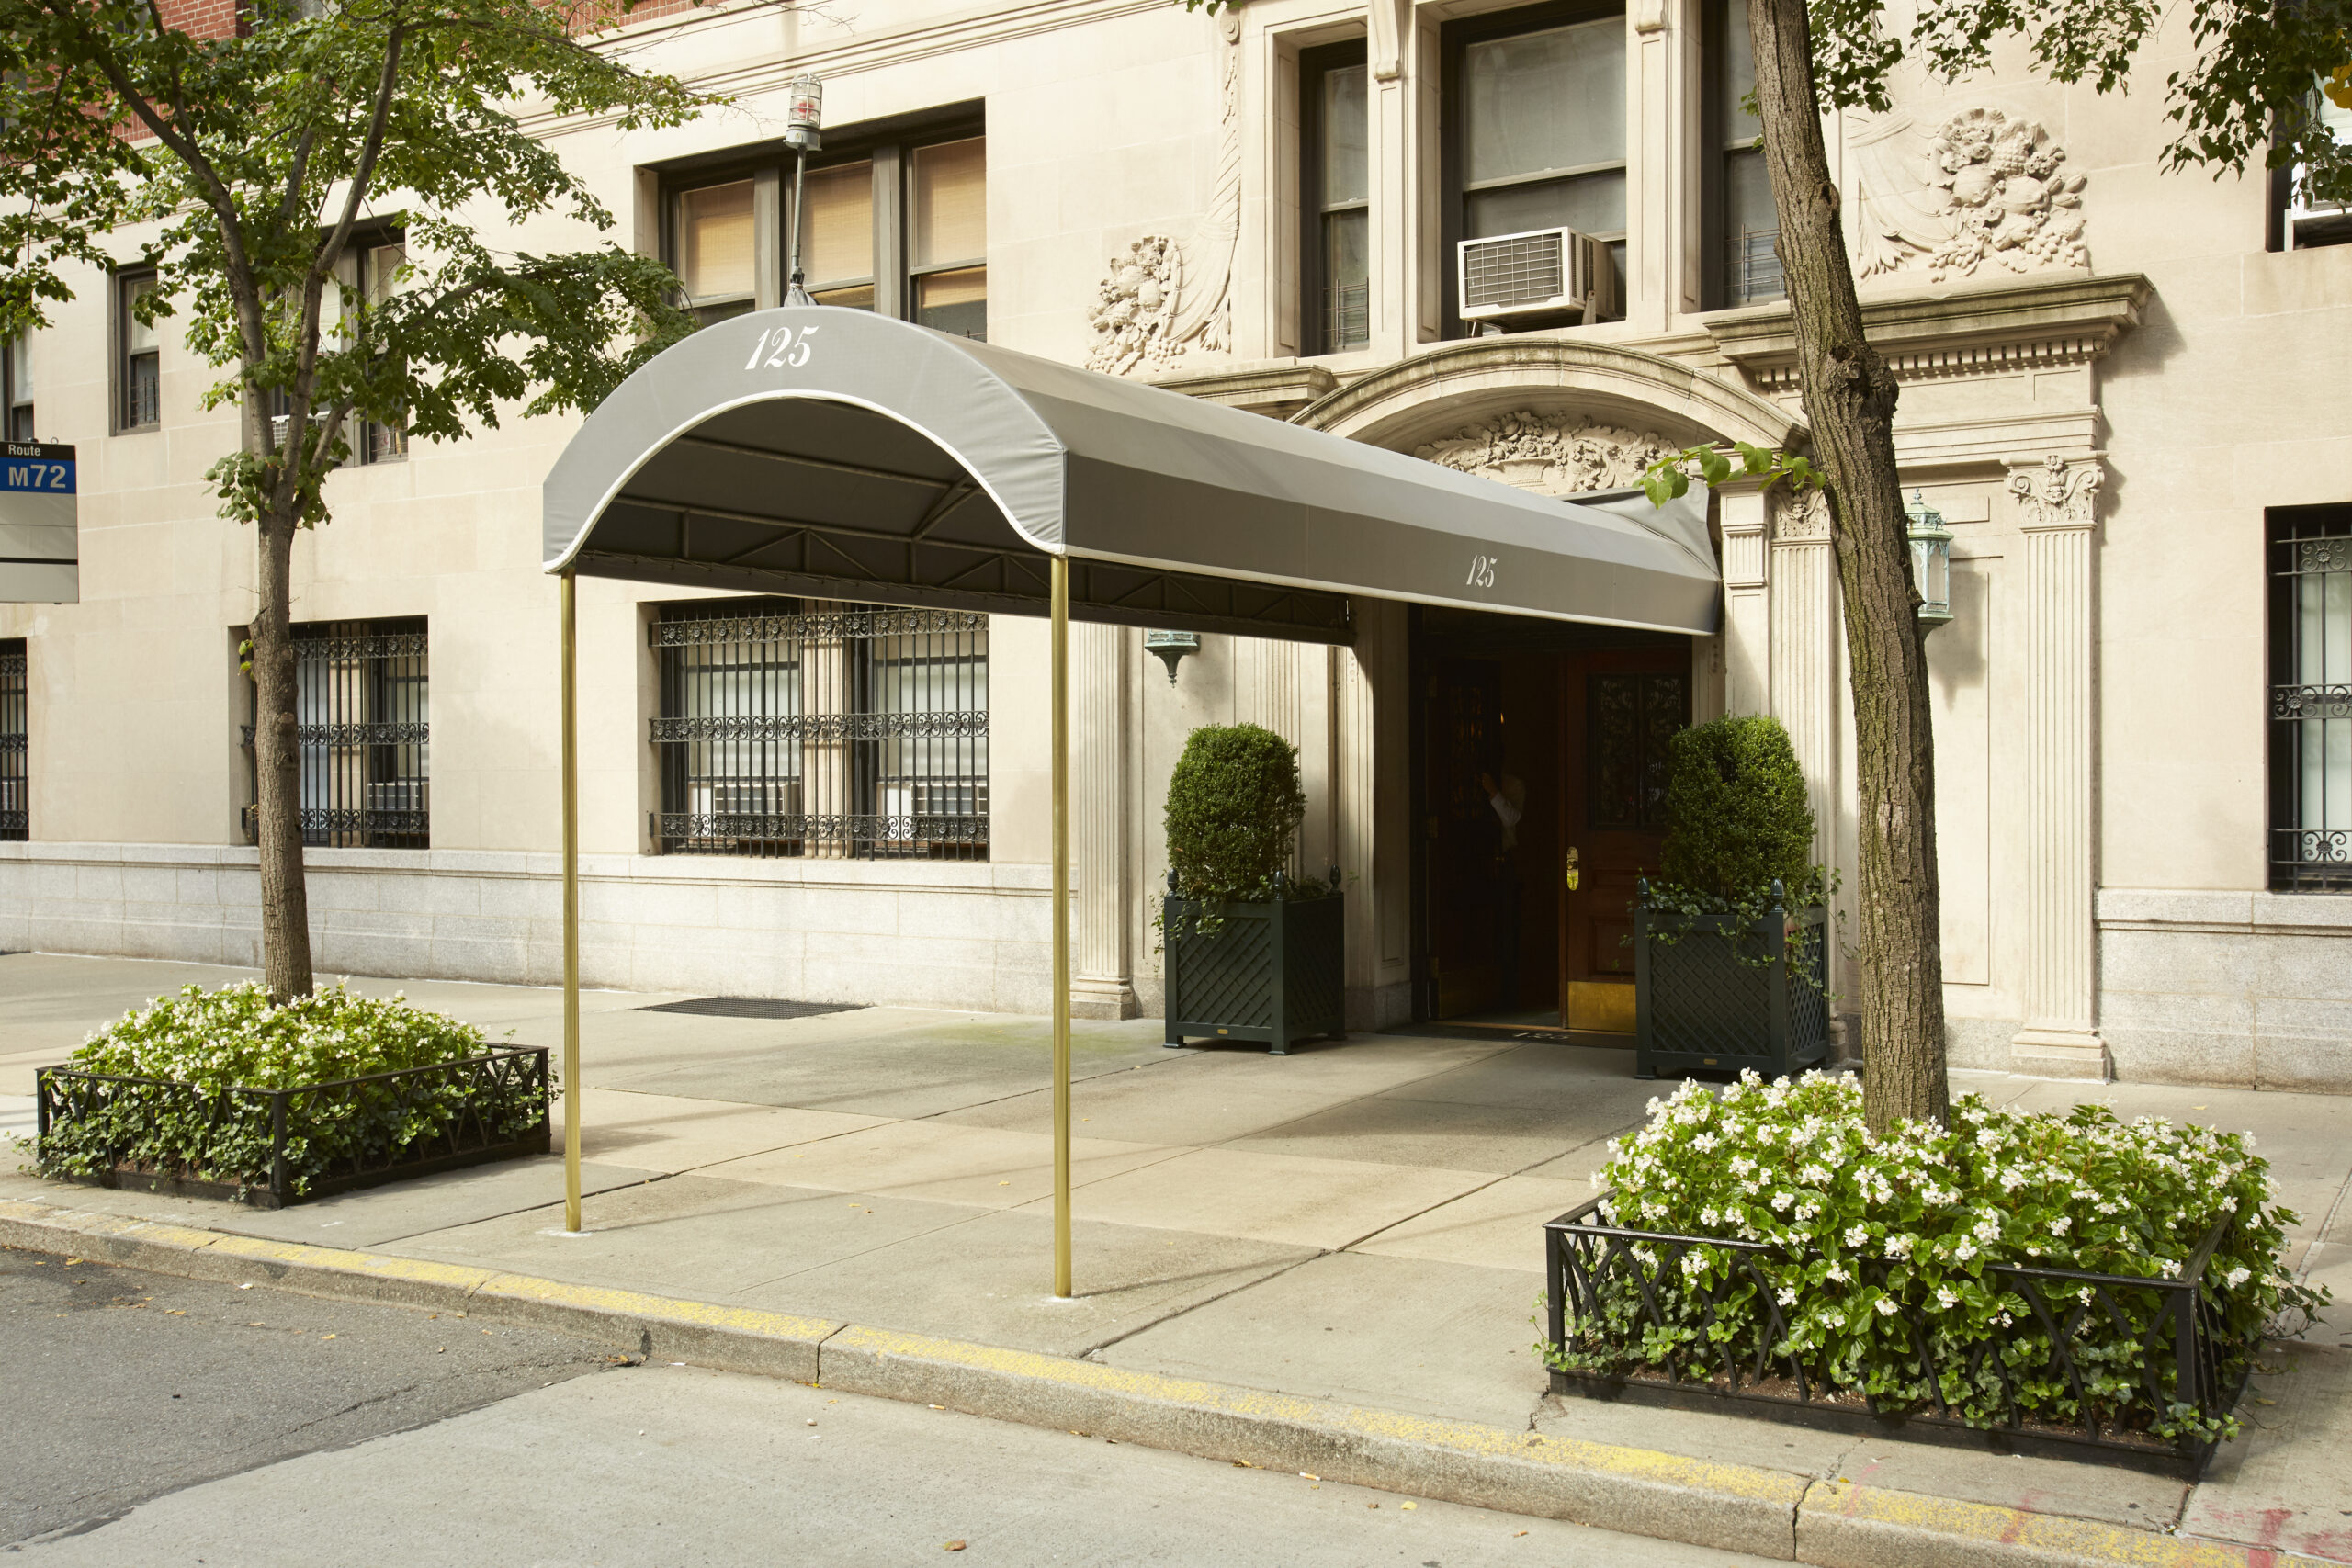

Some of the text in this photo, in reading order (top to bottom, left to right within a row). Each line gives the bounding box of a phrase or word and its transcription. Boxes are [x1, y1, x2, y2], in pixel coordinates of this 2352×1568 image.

[744, 325, 820, 370] 125
[8, 444, 41, 457] Route
[8, 464, 66, 489] M72
[1466, 554, 1498, 588] 125
